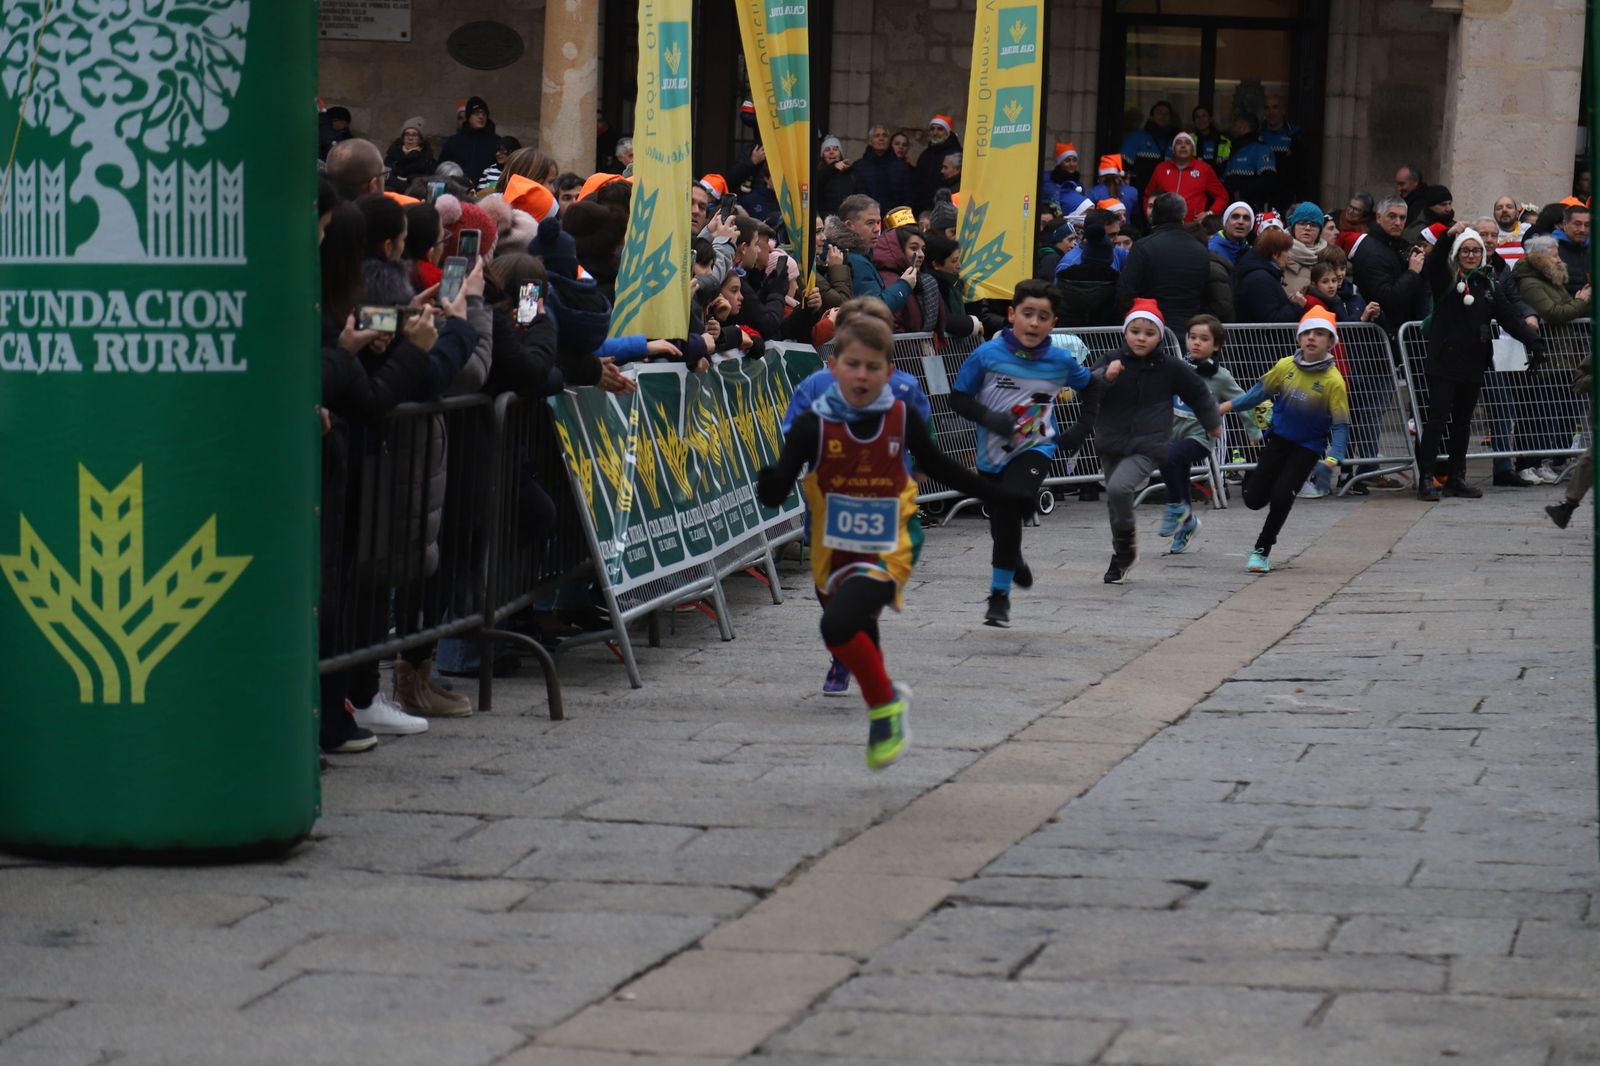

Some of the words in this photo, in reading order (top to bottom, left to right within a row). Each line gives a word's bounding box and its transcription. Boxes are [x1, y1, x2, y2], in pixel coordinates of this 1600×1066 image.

[0, 289, 247, 328] FUNDACION
[0, 331, 82, 374] CAJA
[93, 332, 247, 372] RURAL
[837, 510, 885, 535] 053
